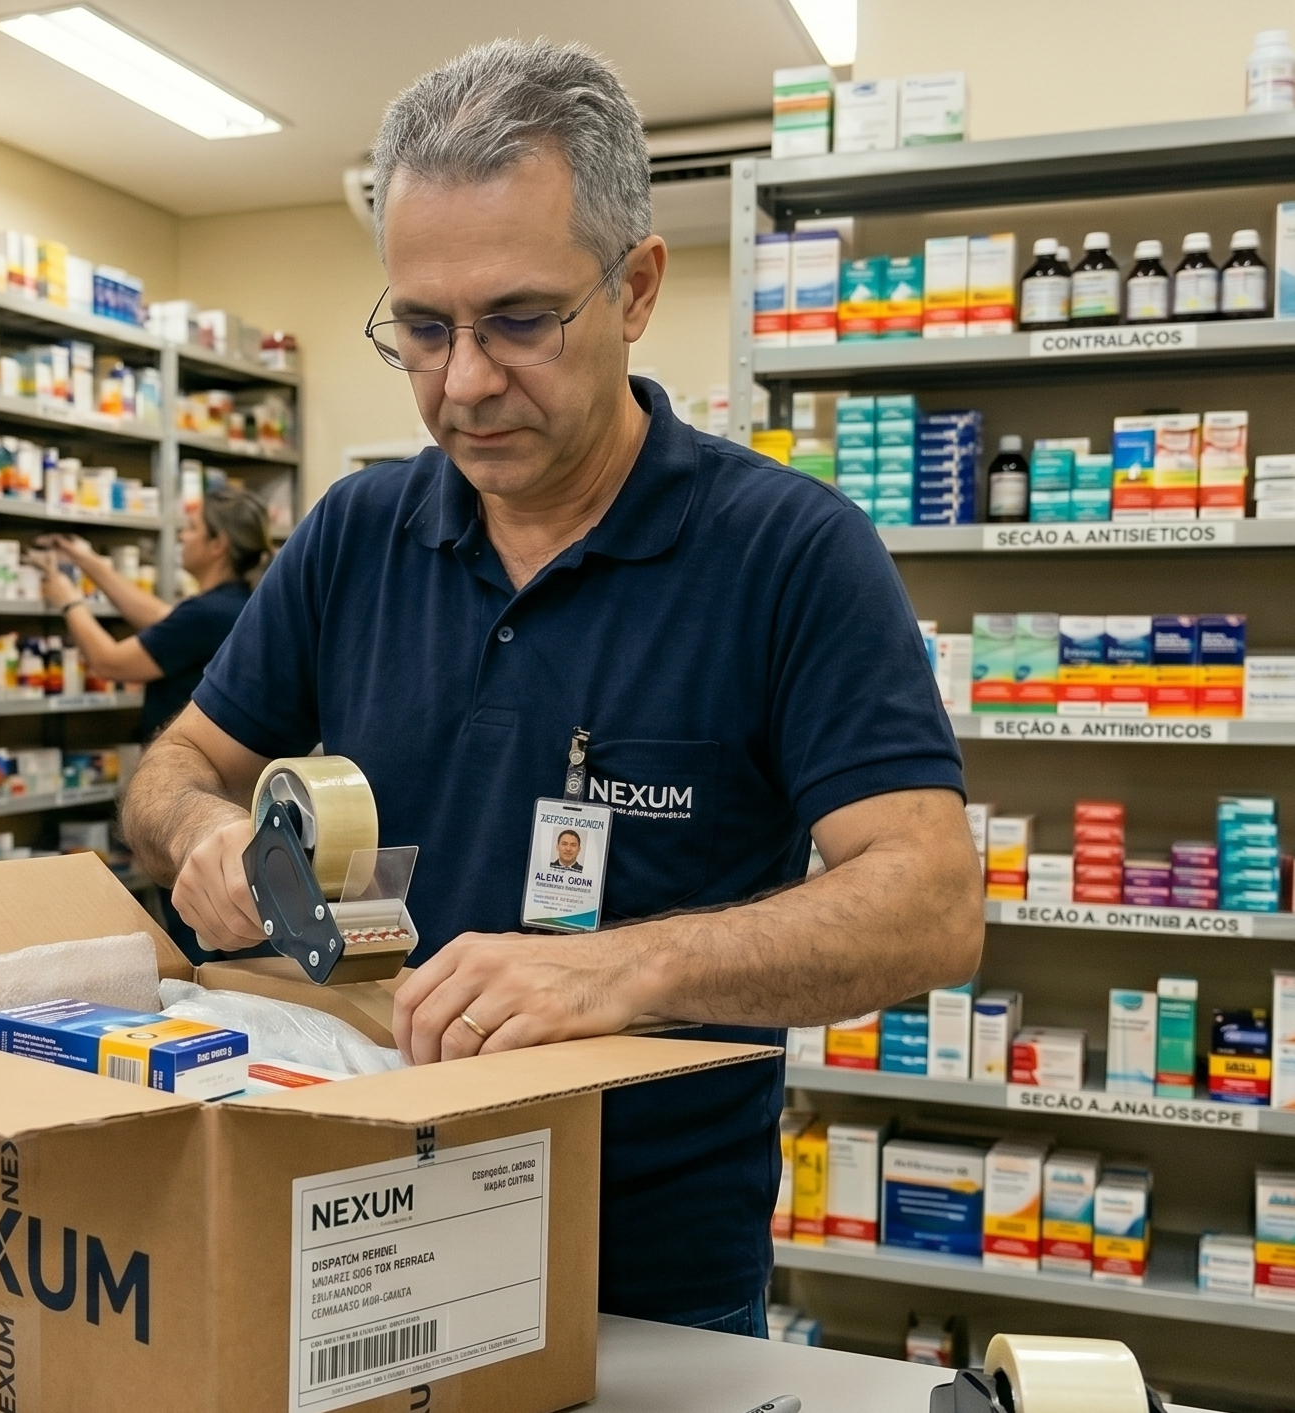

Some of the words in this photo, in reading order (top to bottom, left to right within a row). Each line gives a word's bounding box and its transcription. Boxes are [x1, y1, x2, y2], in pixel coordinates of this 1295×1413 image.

[1043, 331, 1182, 350] CONTRALAÇOS
[589, 777, 693, 809] NEXUM
[312, 1184, 414, 1232] NEXUM
[375, 1262, 392, 1274] TOX
